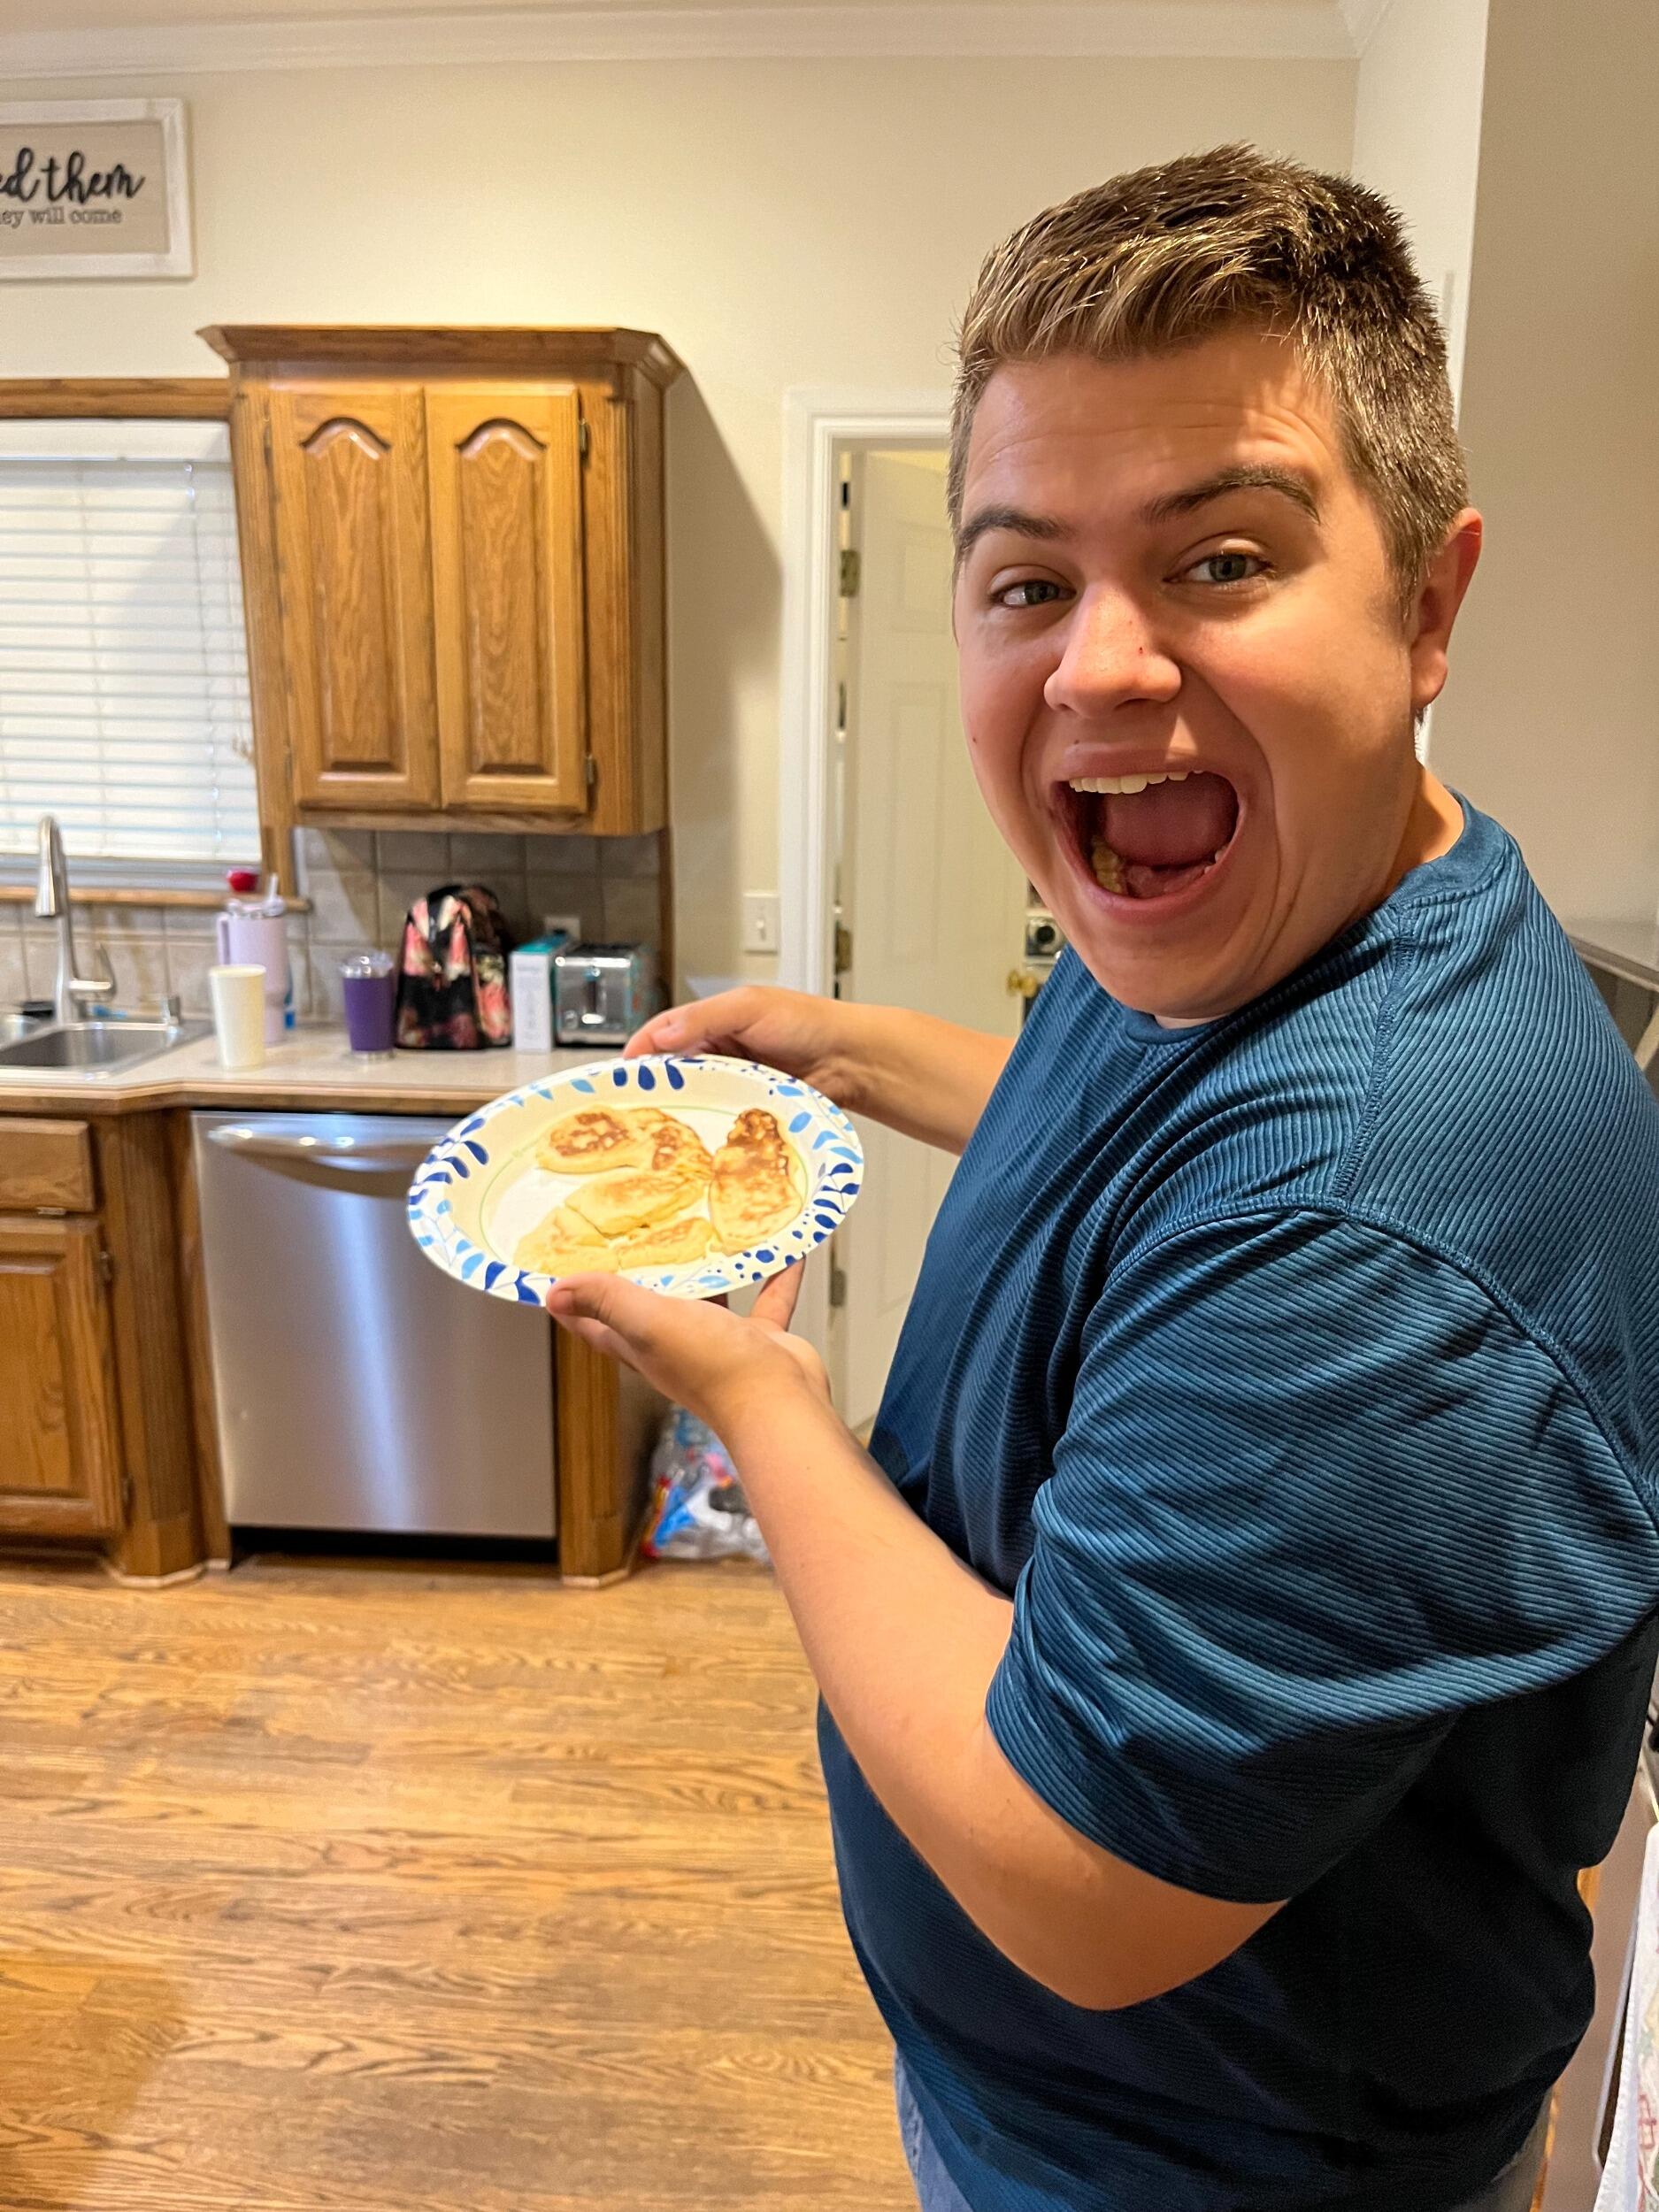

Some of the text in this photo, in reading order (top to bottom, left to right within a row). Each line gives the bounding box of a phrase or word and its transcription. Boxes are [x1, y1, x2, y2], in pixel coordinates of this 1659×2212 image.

[40, 150, 146, 204] them
[0, 206, 122, 229] ey will come
